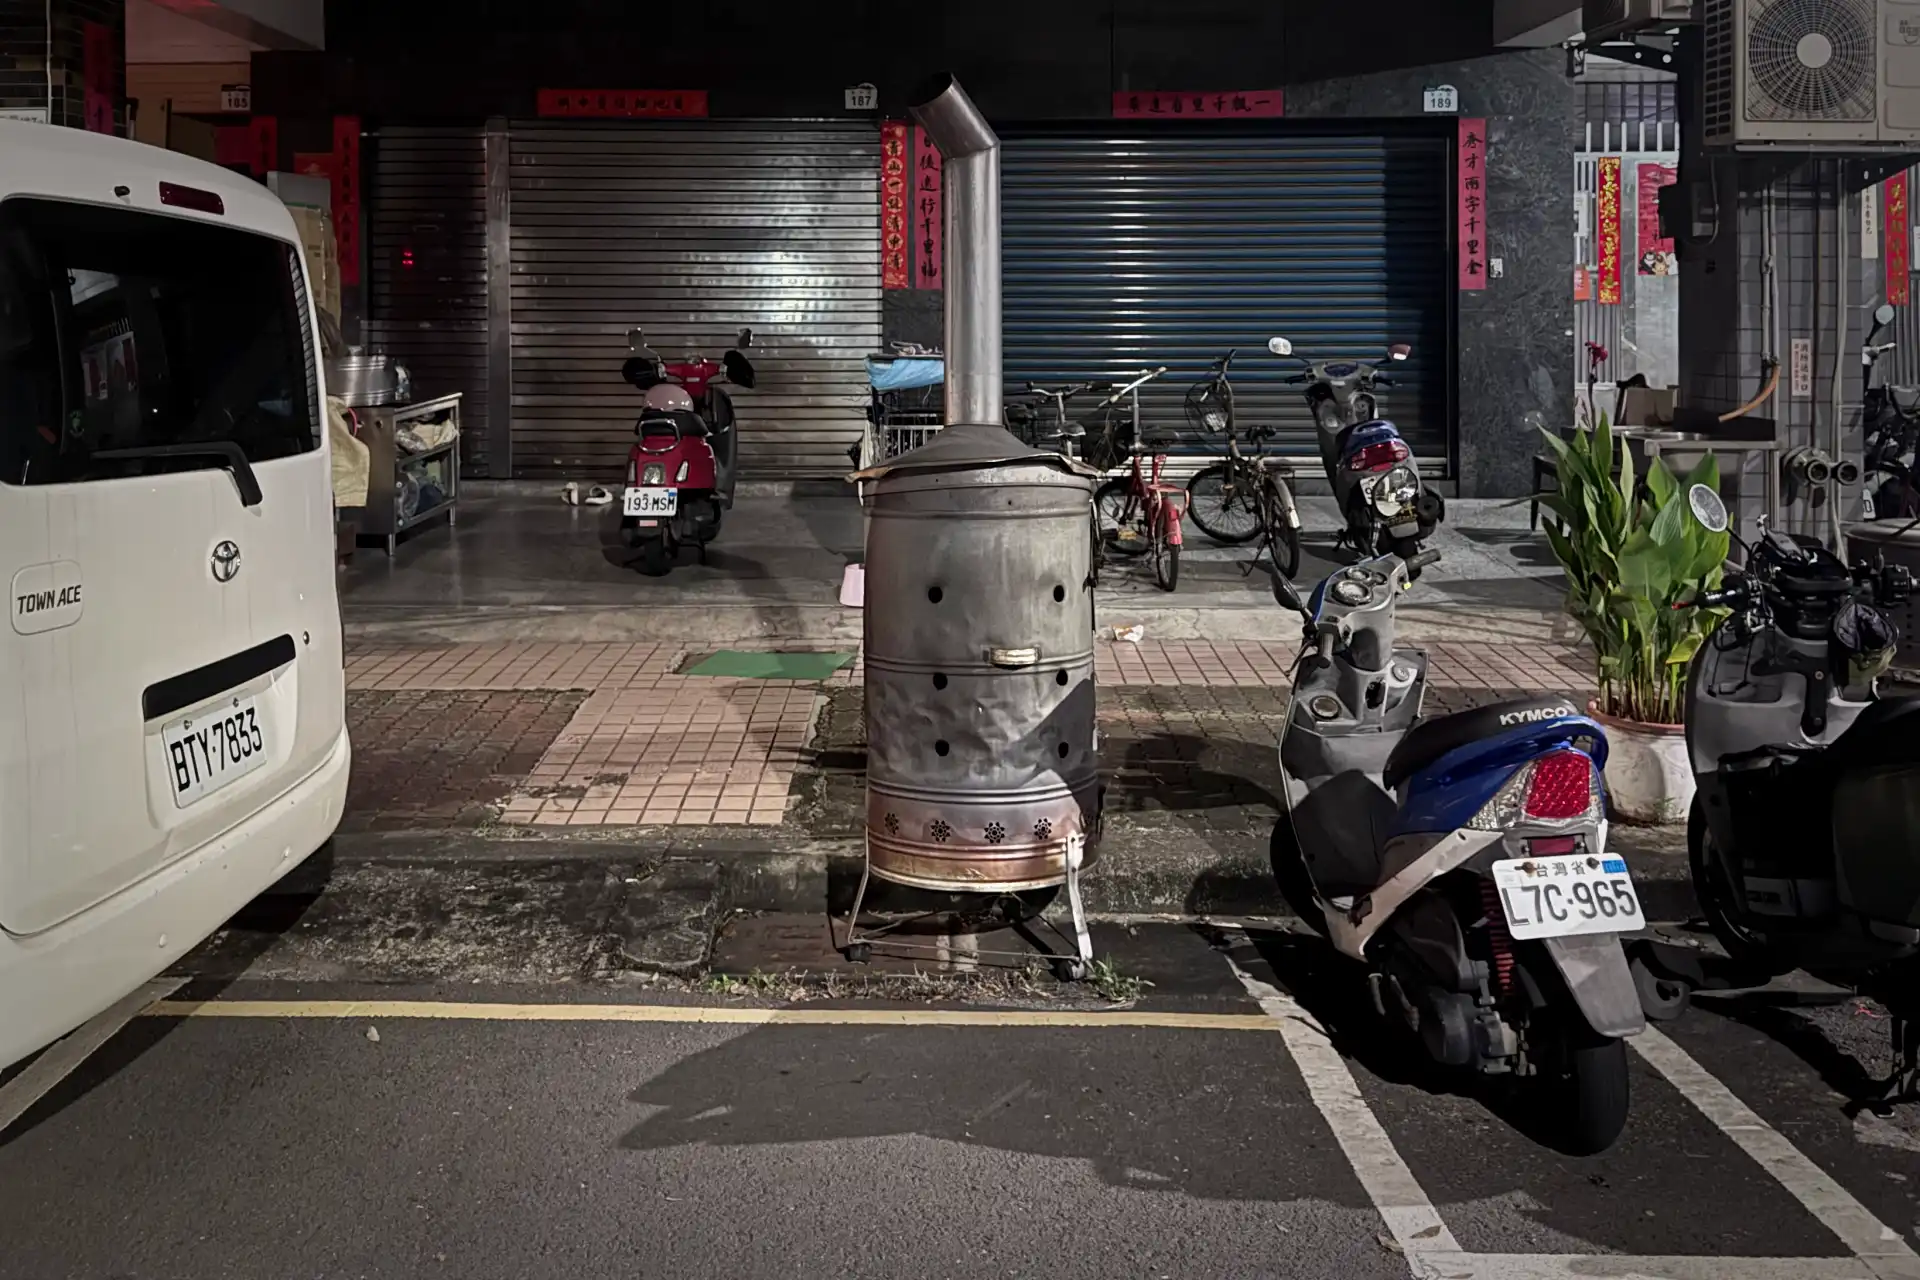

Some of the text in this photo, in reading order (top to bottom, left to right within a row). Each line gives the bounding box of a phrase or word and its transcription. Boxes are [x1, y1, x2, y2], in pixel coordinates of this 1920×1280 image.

[852, 95, 871, 106] 187
[1431, 98, 1452, 109] 189
[17, 584, 81, 614] TOWN ACE
[1499, 707, 1568, 726] KYMCO
[1536, 861, 1586, 877] 台灣省
